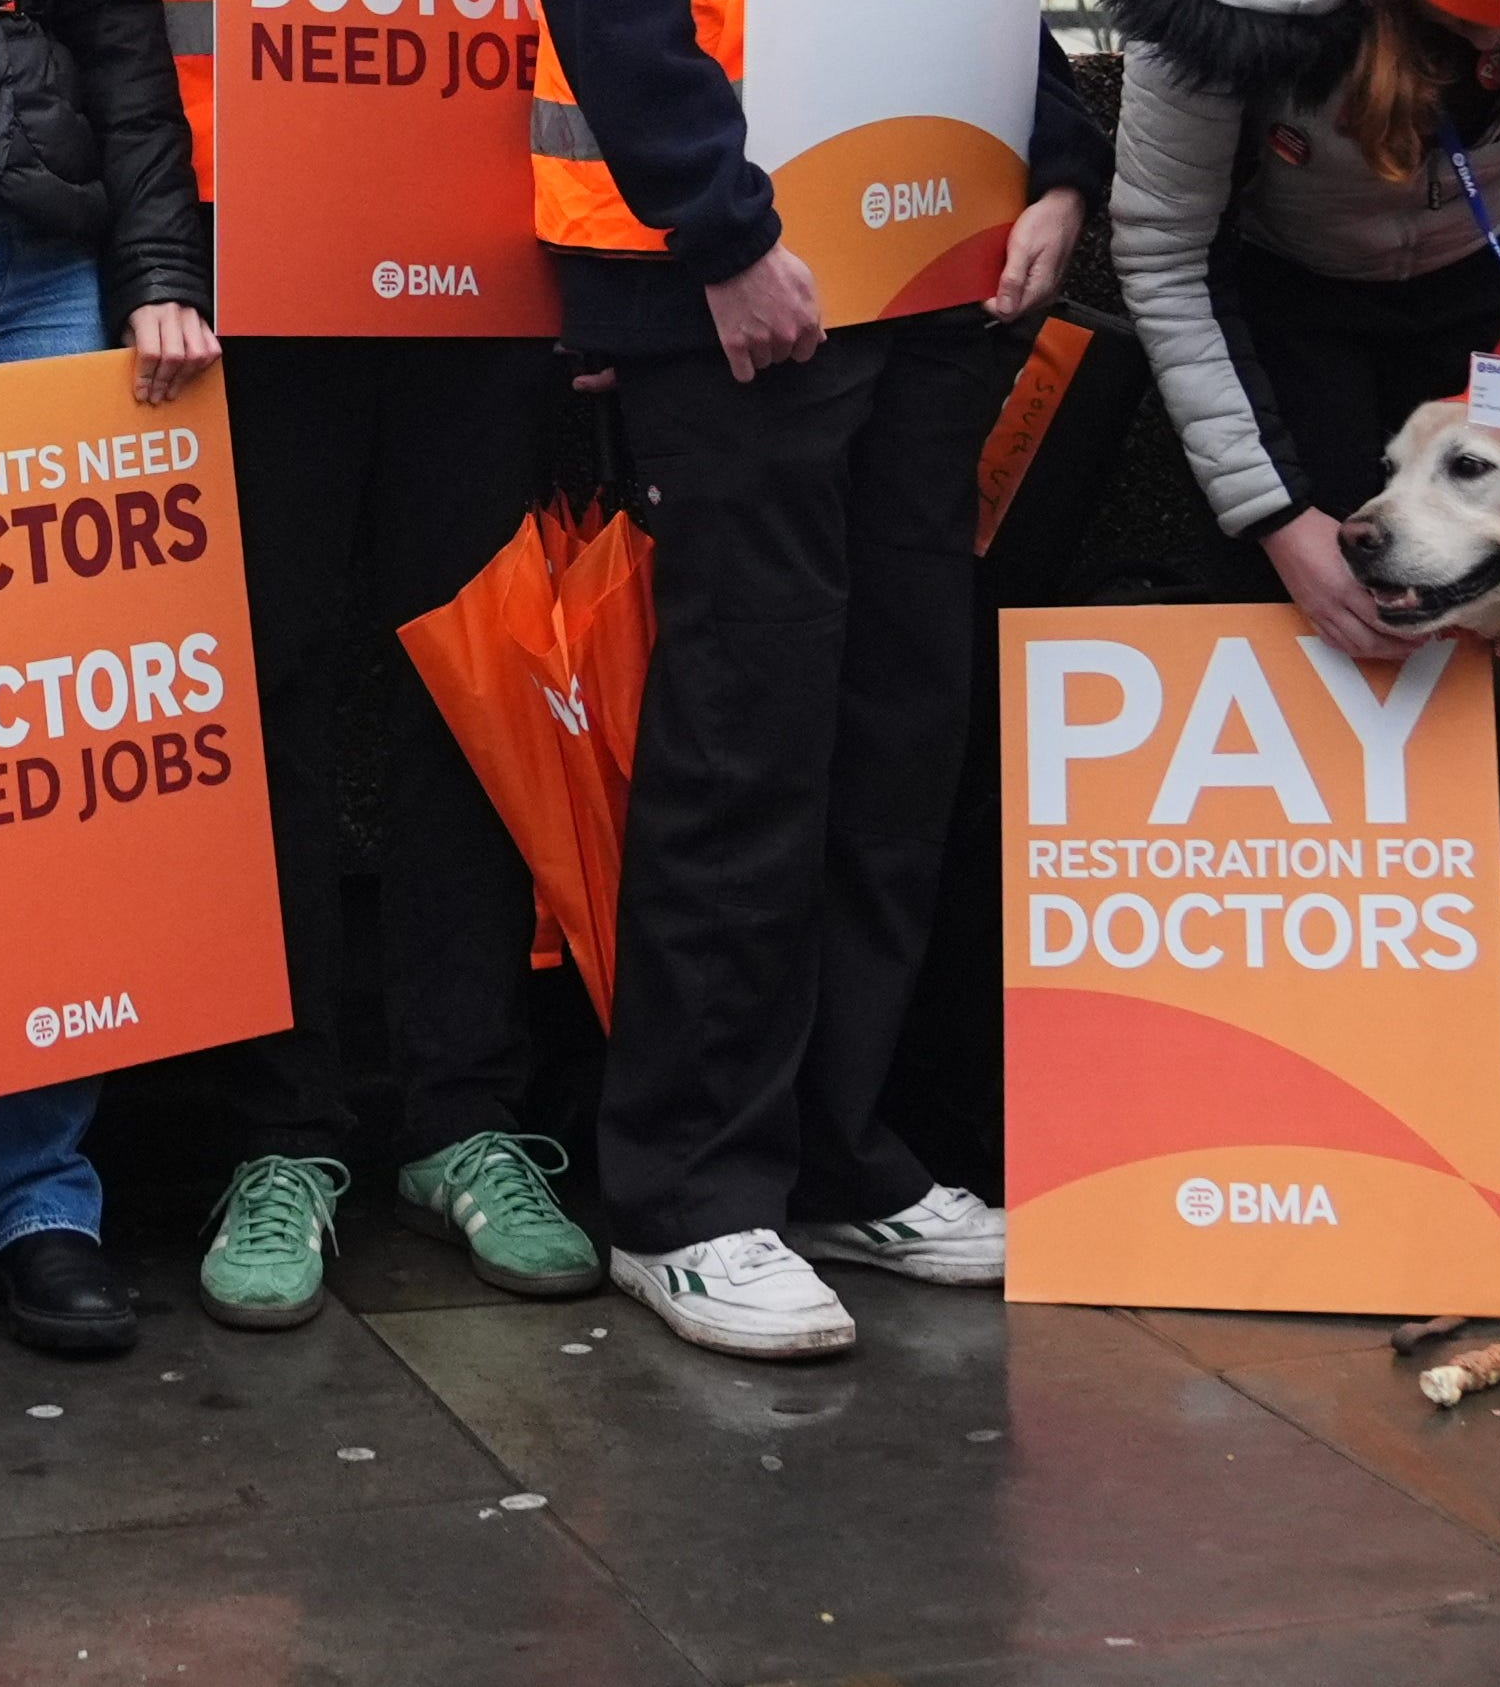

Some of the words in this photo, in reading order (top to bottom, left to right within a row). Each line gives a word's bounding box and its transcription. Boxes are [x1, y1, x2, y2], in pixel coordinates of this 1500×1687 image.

[252, 23, 425, 86] NEED
[894, 178, 953, 222] BMA
[408, 265, 478, 296] BMA
[78, 427, 199, 484] NEED
[1025, 637, 1459, 824] PAY
[78, 724, 232, 822] JOBS
[1028, 839, 1362, 878] RESTORATION
[1377, 839, 1474, 878] FOR
[1029, 893, 1479, 971] DOCTORS
[63, 992, 139, 1038] BMA
[1229, 1183, 1338, 1226] BMA
